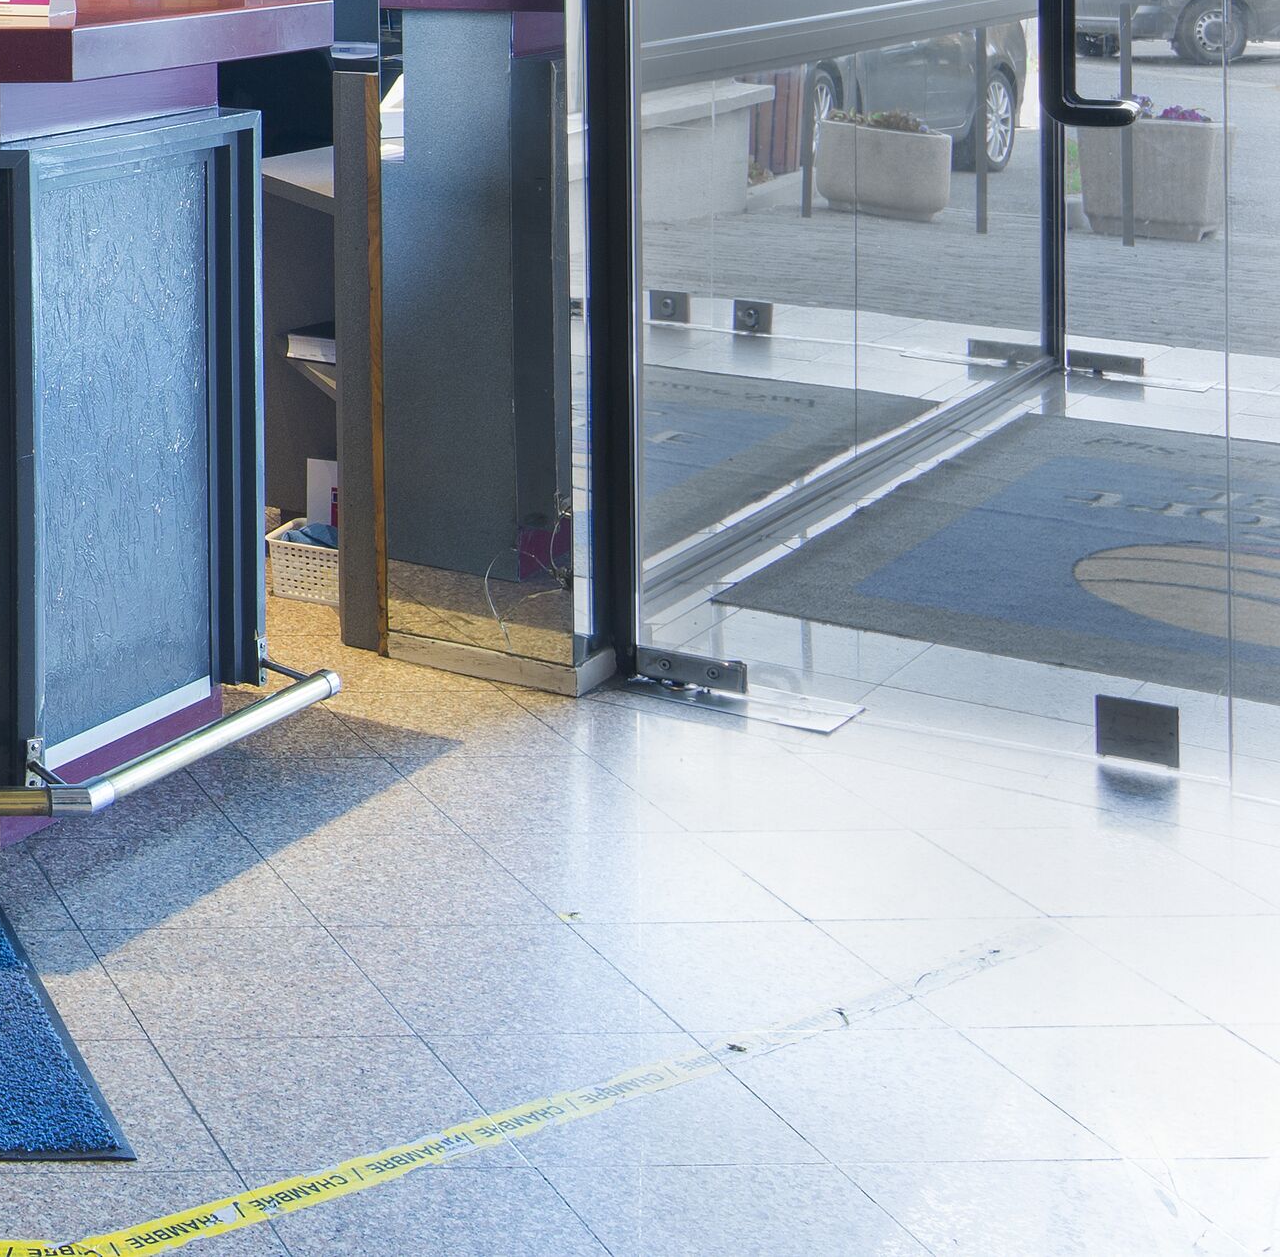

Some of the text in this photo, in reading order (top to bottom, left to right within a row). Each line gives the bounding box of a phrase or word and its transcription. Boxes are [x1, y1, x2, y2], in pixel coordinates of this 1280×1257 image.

[579, 1072, 664, 1103] CHAMBRE
[476, 1106, 565, 1137] CHAMBRE
[252, 1174, 350, 1210] CHAMBRE
